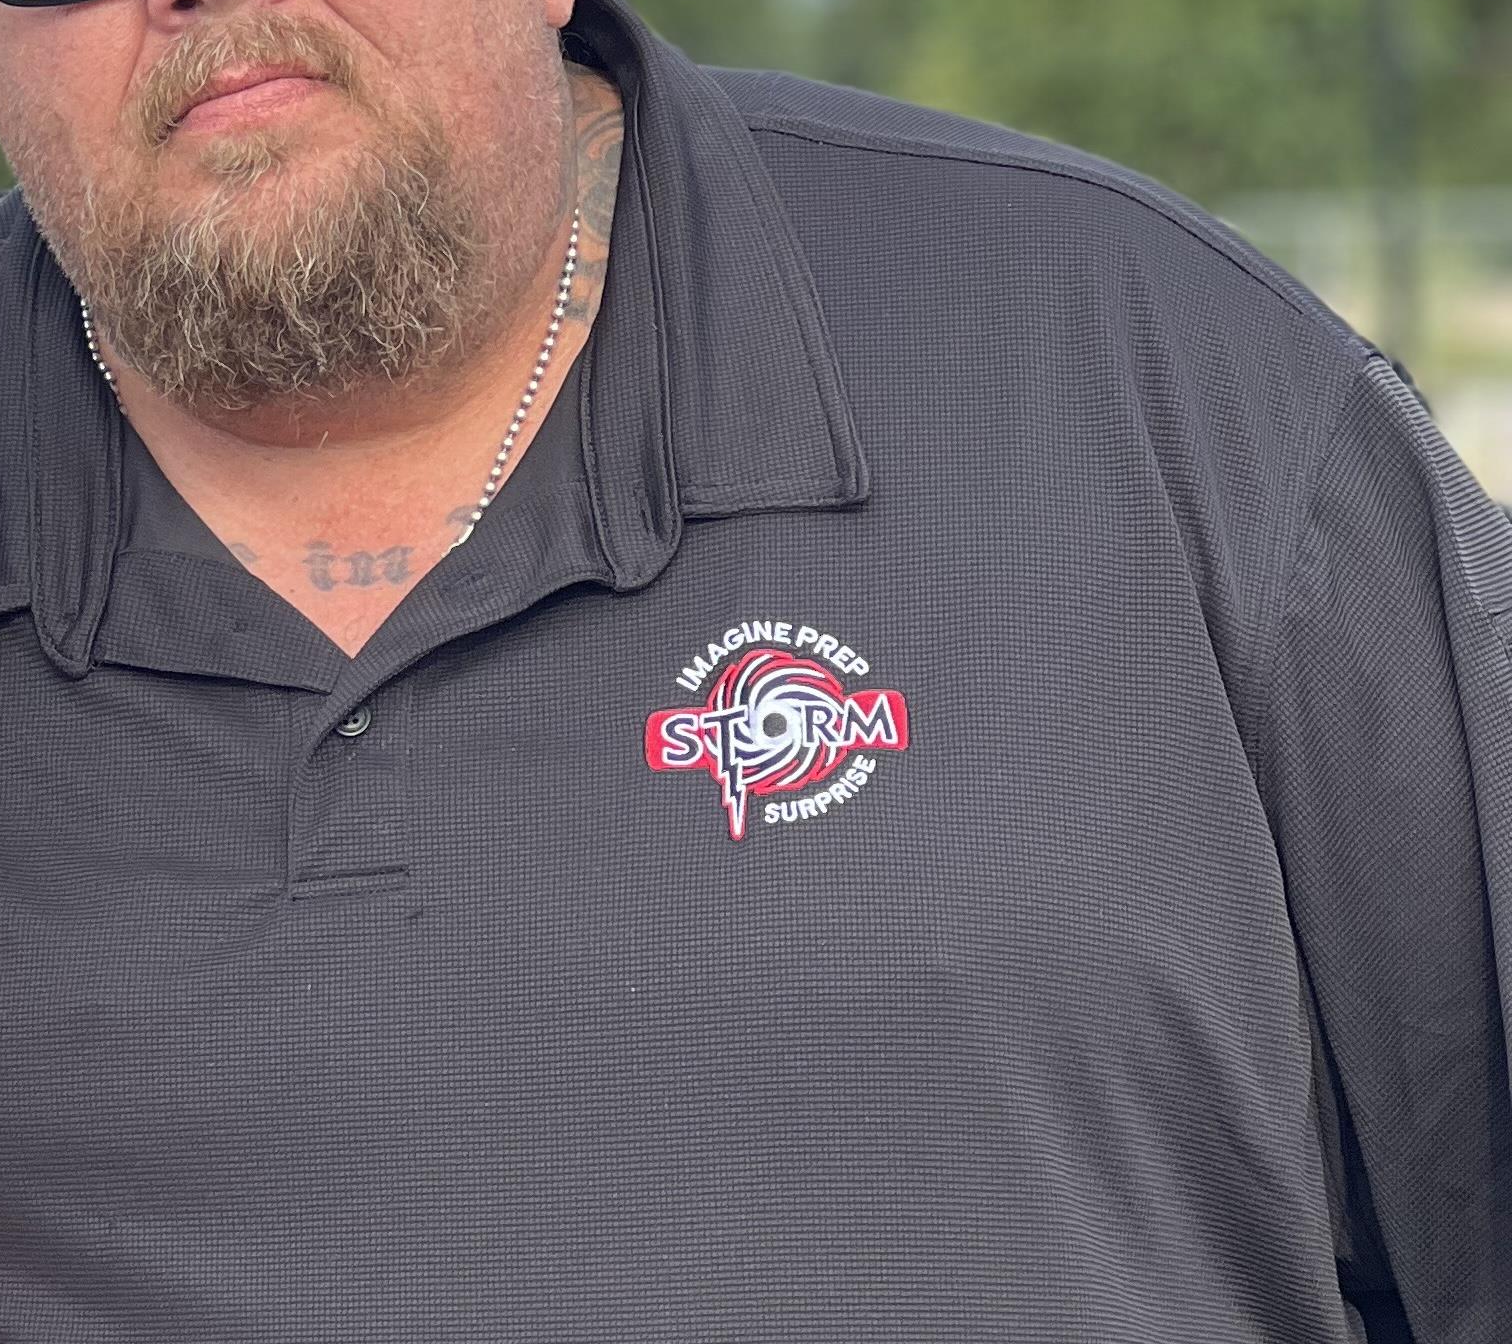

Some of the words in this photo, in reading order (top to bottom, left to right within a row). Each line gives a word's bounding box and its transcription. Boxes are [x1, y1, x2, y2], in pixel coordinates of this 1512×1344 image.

[676, 620, 793, 692] IMAGINE
[795, 626, 870, 677] PREP
[661, 693, 899, 837] STORM
[764, 754, 877, 824] SURPRISE
